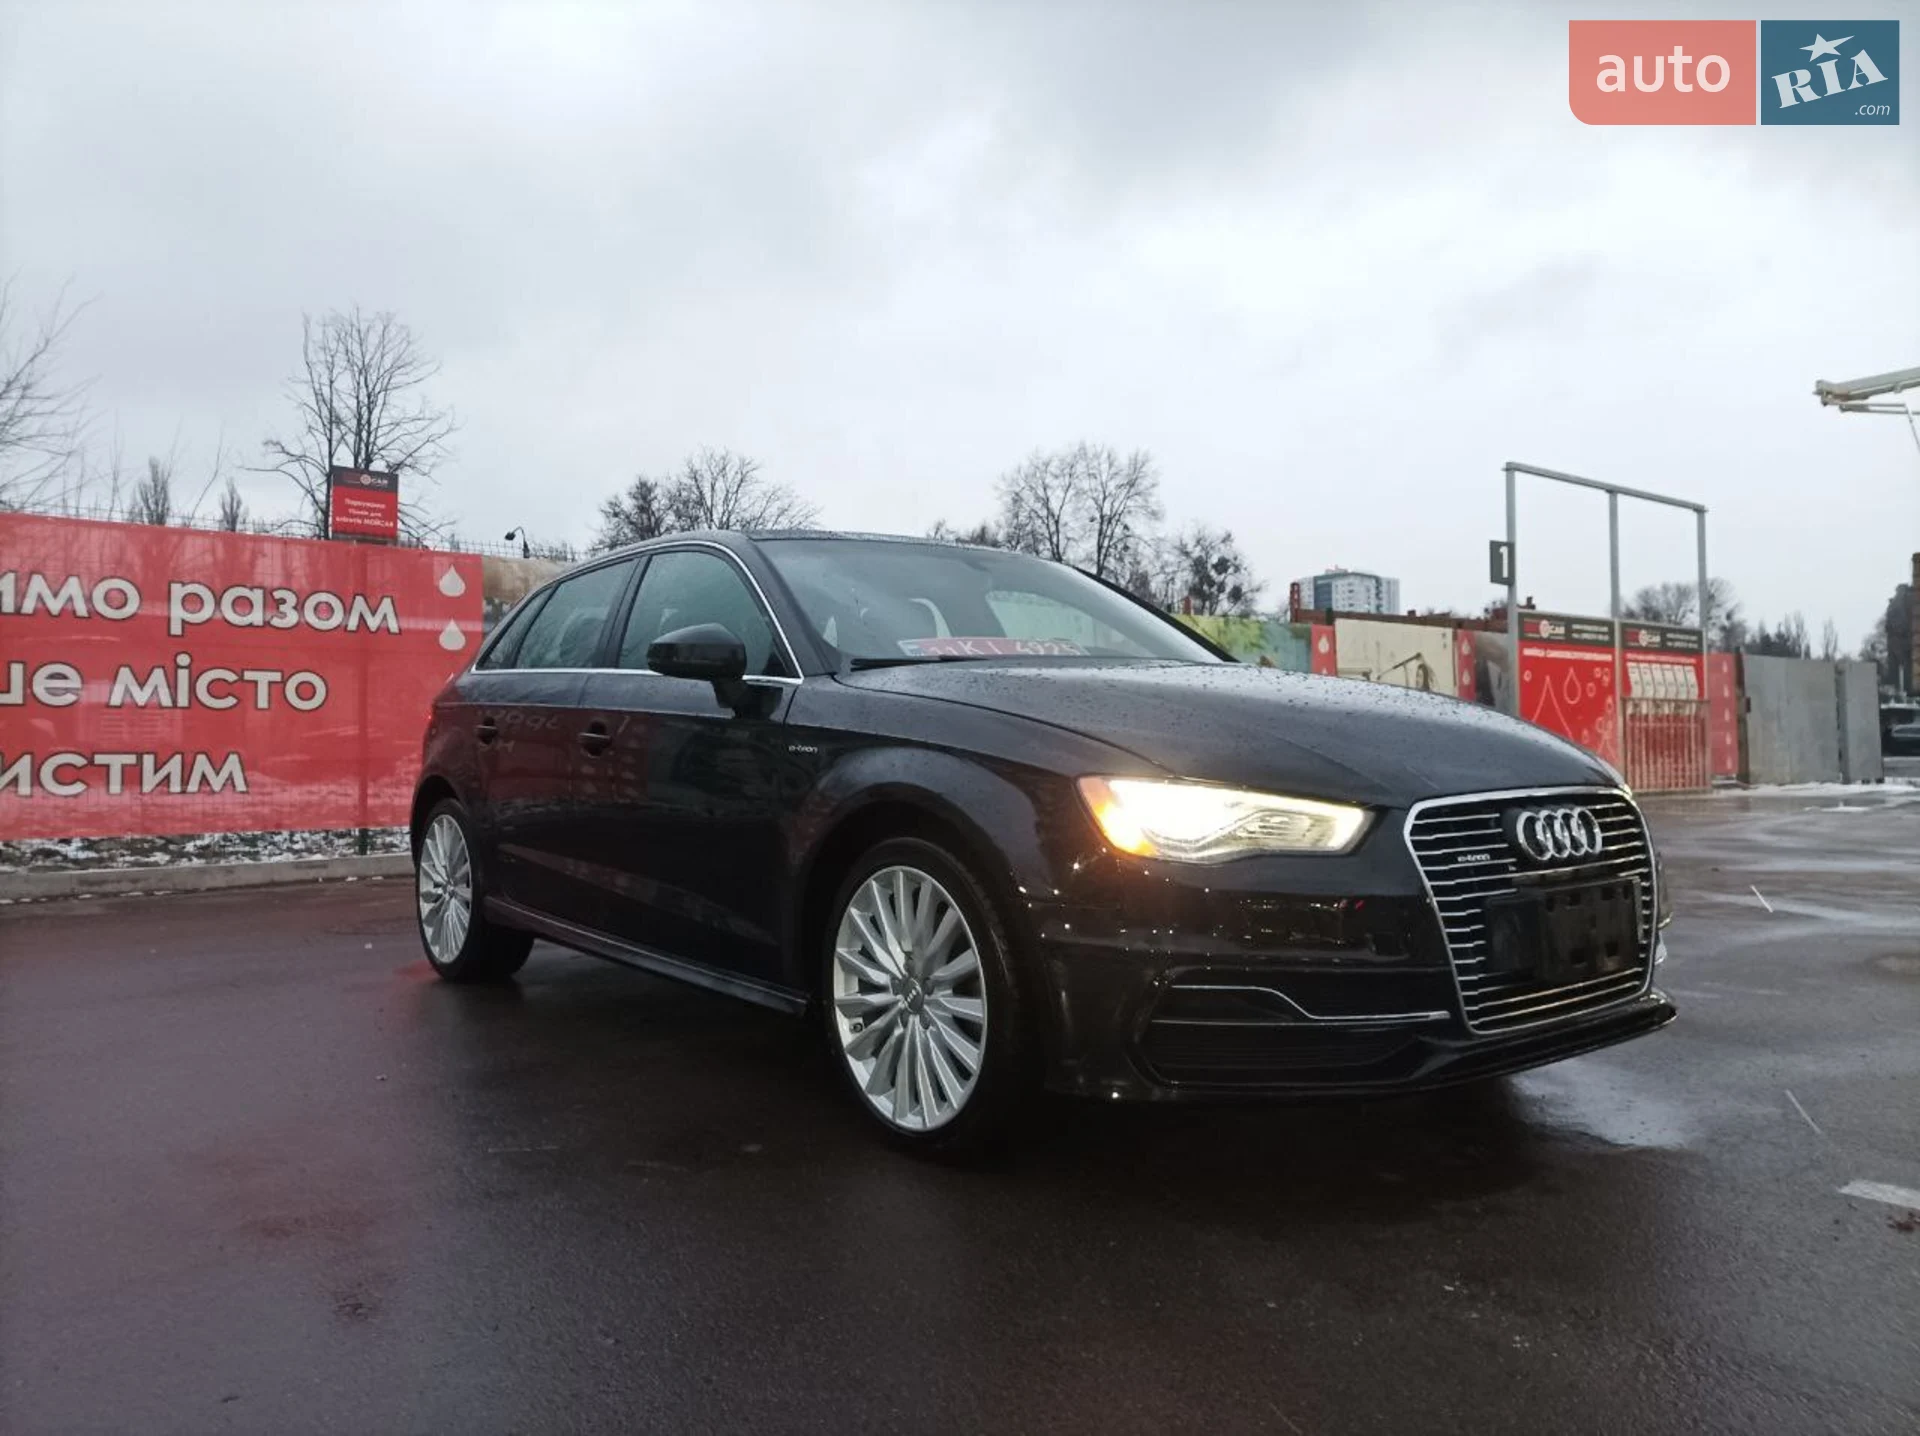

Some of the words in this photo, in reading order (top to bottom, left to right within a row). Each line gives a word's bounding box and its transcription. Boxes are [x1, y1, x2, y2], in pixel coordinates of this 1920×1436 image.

[1499, 545, 1508, 578] 1
[168, 578, 400, 636] разом
[108, 652, 328, 711] місто
